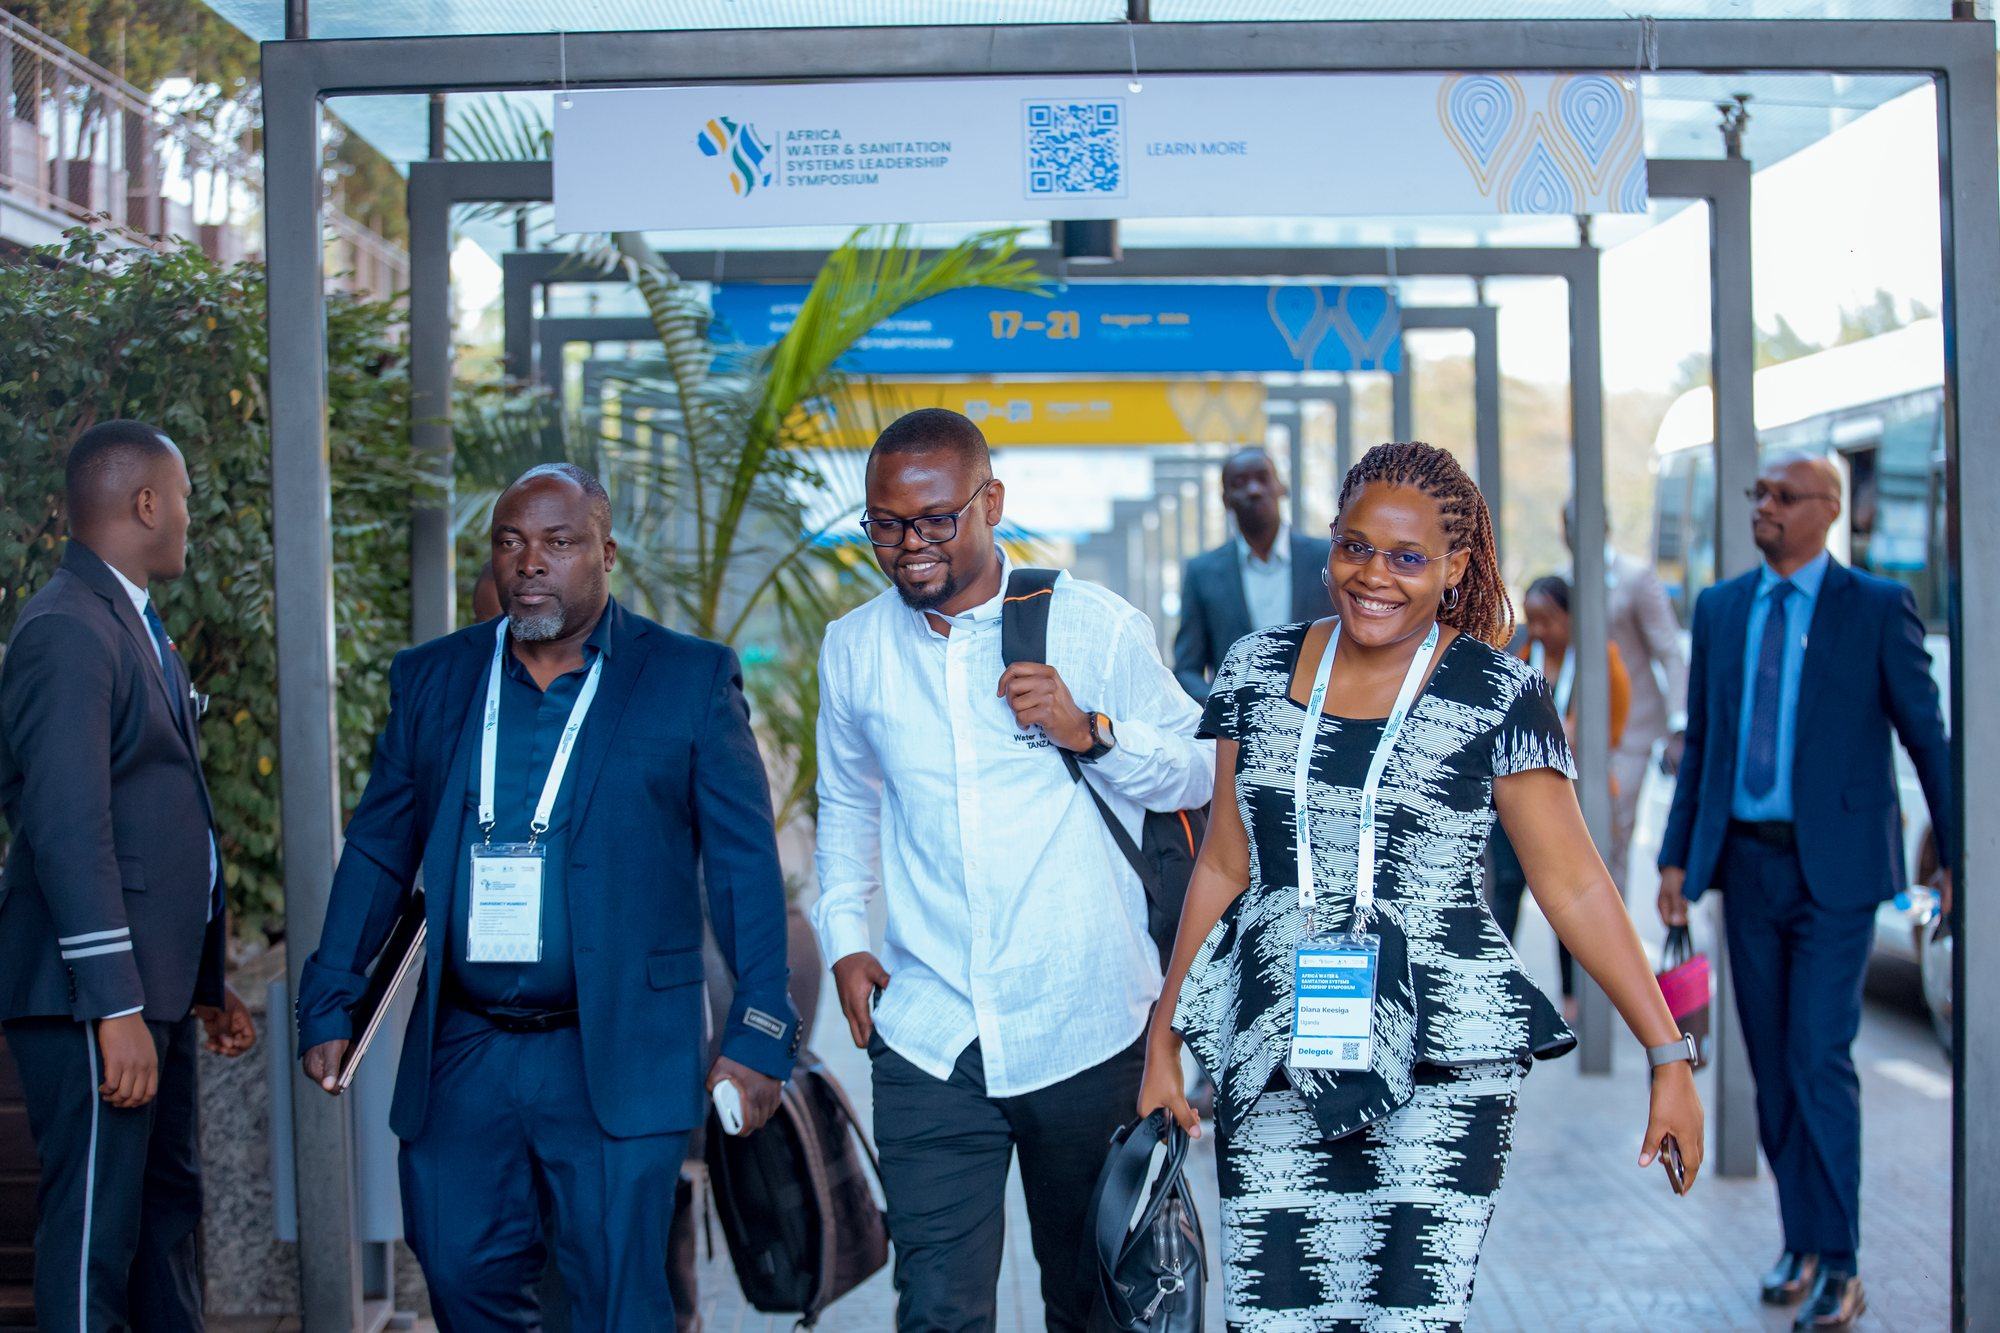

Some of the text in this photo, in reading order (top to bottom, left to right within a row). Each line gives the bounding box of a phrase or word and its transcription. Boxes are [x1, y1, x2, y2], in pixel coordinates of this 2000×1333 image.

[786, 129, 842, 141] AFRICA
[786, 141, 952, 156] WATER & SANITATION
[1146, 141, 1248, 156] LEARN MORE
[786, 156, 949, 171] SYSTEMS LEADERSHIP
[786, 173, 879, 186] SYMPOSIUM
[1298, 1048, 1333, 1056] Delegate
